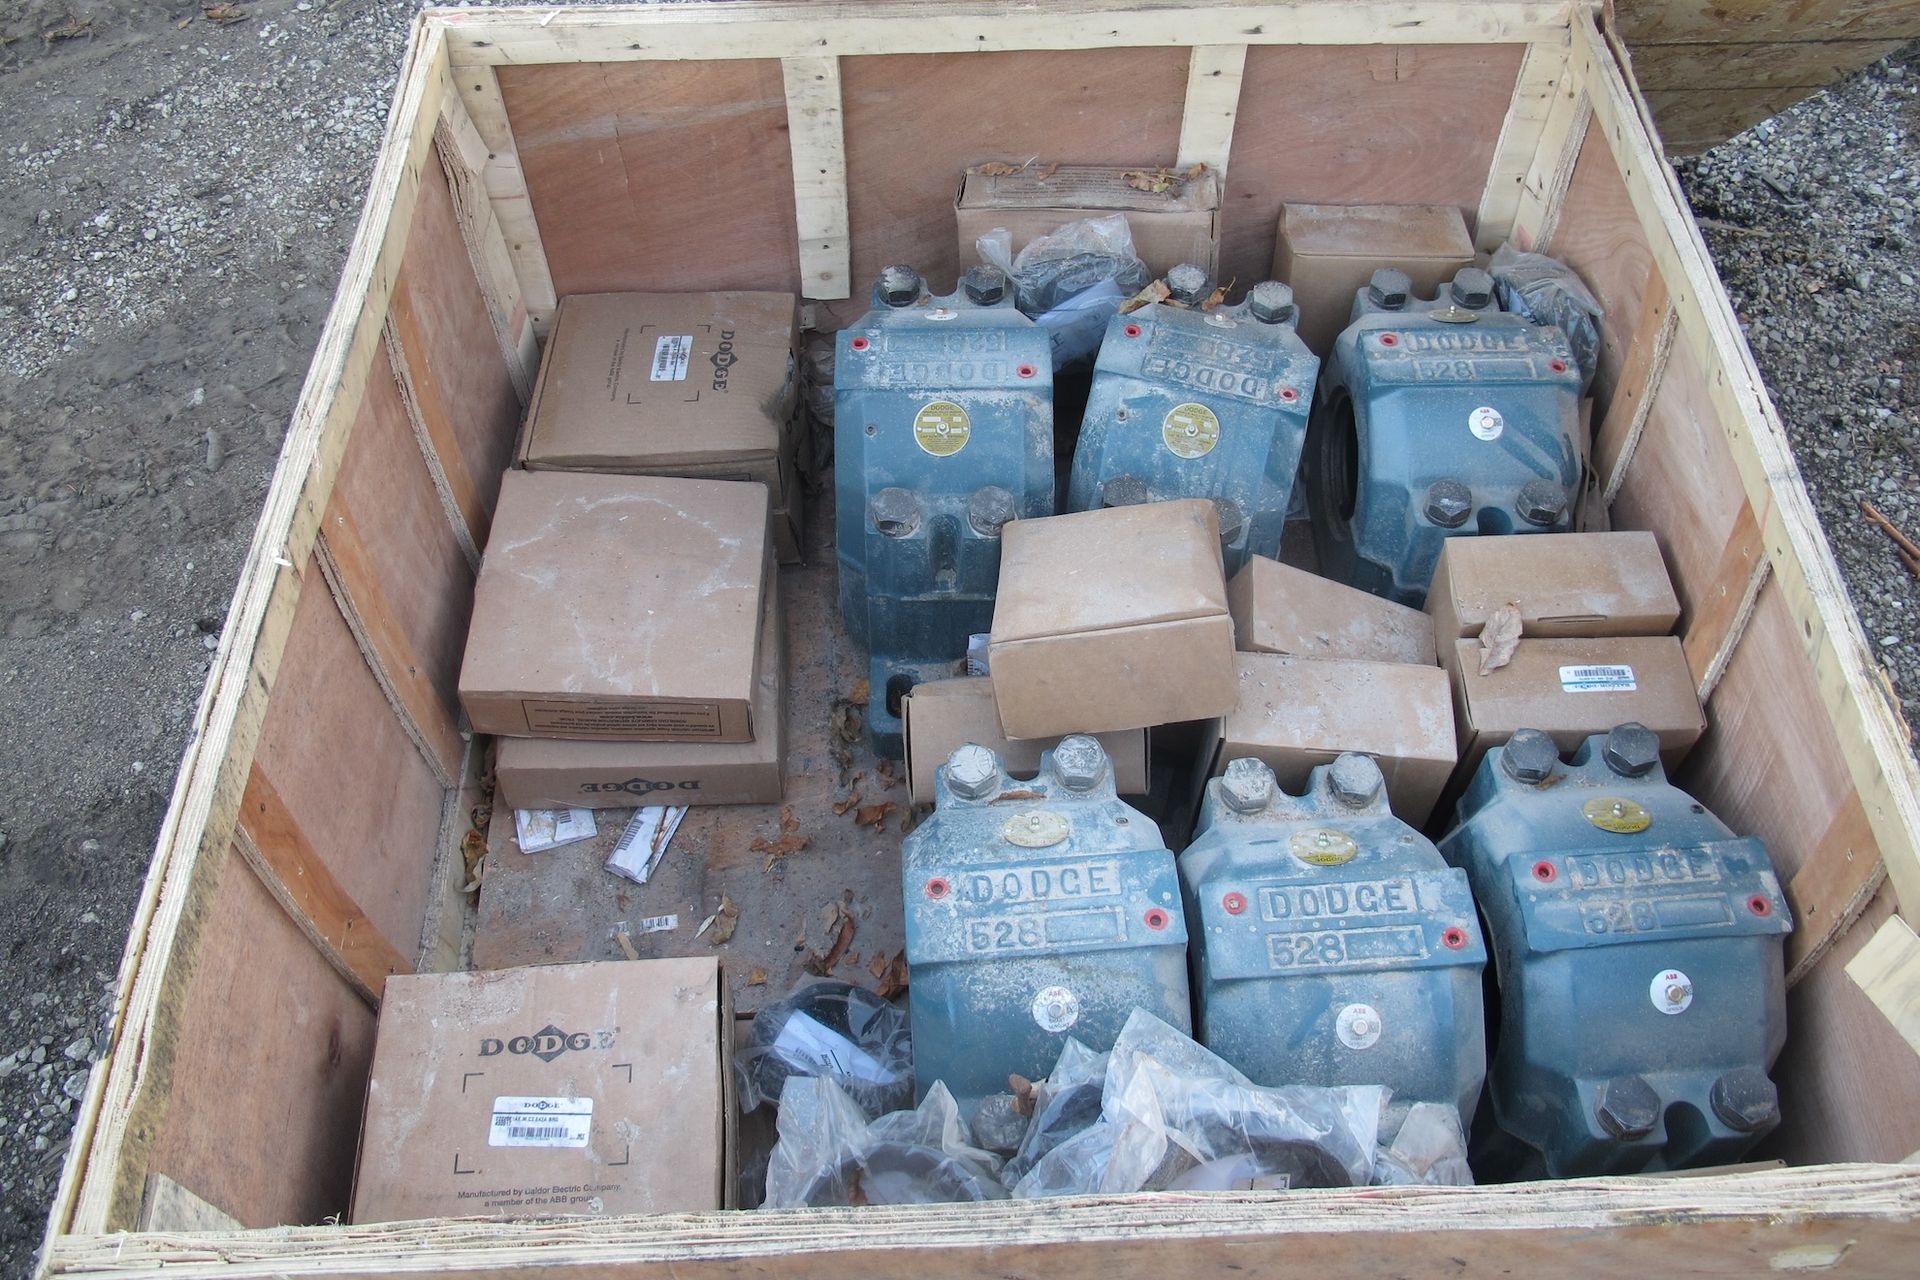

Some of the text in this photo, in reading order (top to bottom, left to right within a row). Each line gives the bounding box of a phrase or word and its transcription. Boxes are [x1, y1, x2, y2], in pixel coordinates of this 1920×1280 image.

[711, 330, 737, 391] DODGE
[1149, 358, 1259, 397] DODGE
[581, 778, 702, 794] DODGE
[972, 864, 1110, 903] DODGE
[1577, 850, 1712, 887] DODGE
[1269, 883, 1408, 919] DODGE
[969, 917, 1042, 950] 528
[1273, 934, 1345, 967] 528
[478, 1029, 616, 1059] DODGE
[458, 1189, 513, 1199] Manufactured
[512, 1187, 523, 1197] by
[552, 1185, 582, 1194] Electric
[492, 1198, 524, 1207] member
[525, 1197, 534, 1205] of
[535, 1196, 548, 1204] the
[549, 1194, 567, 1204] ABB
